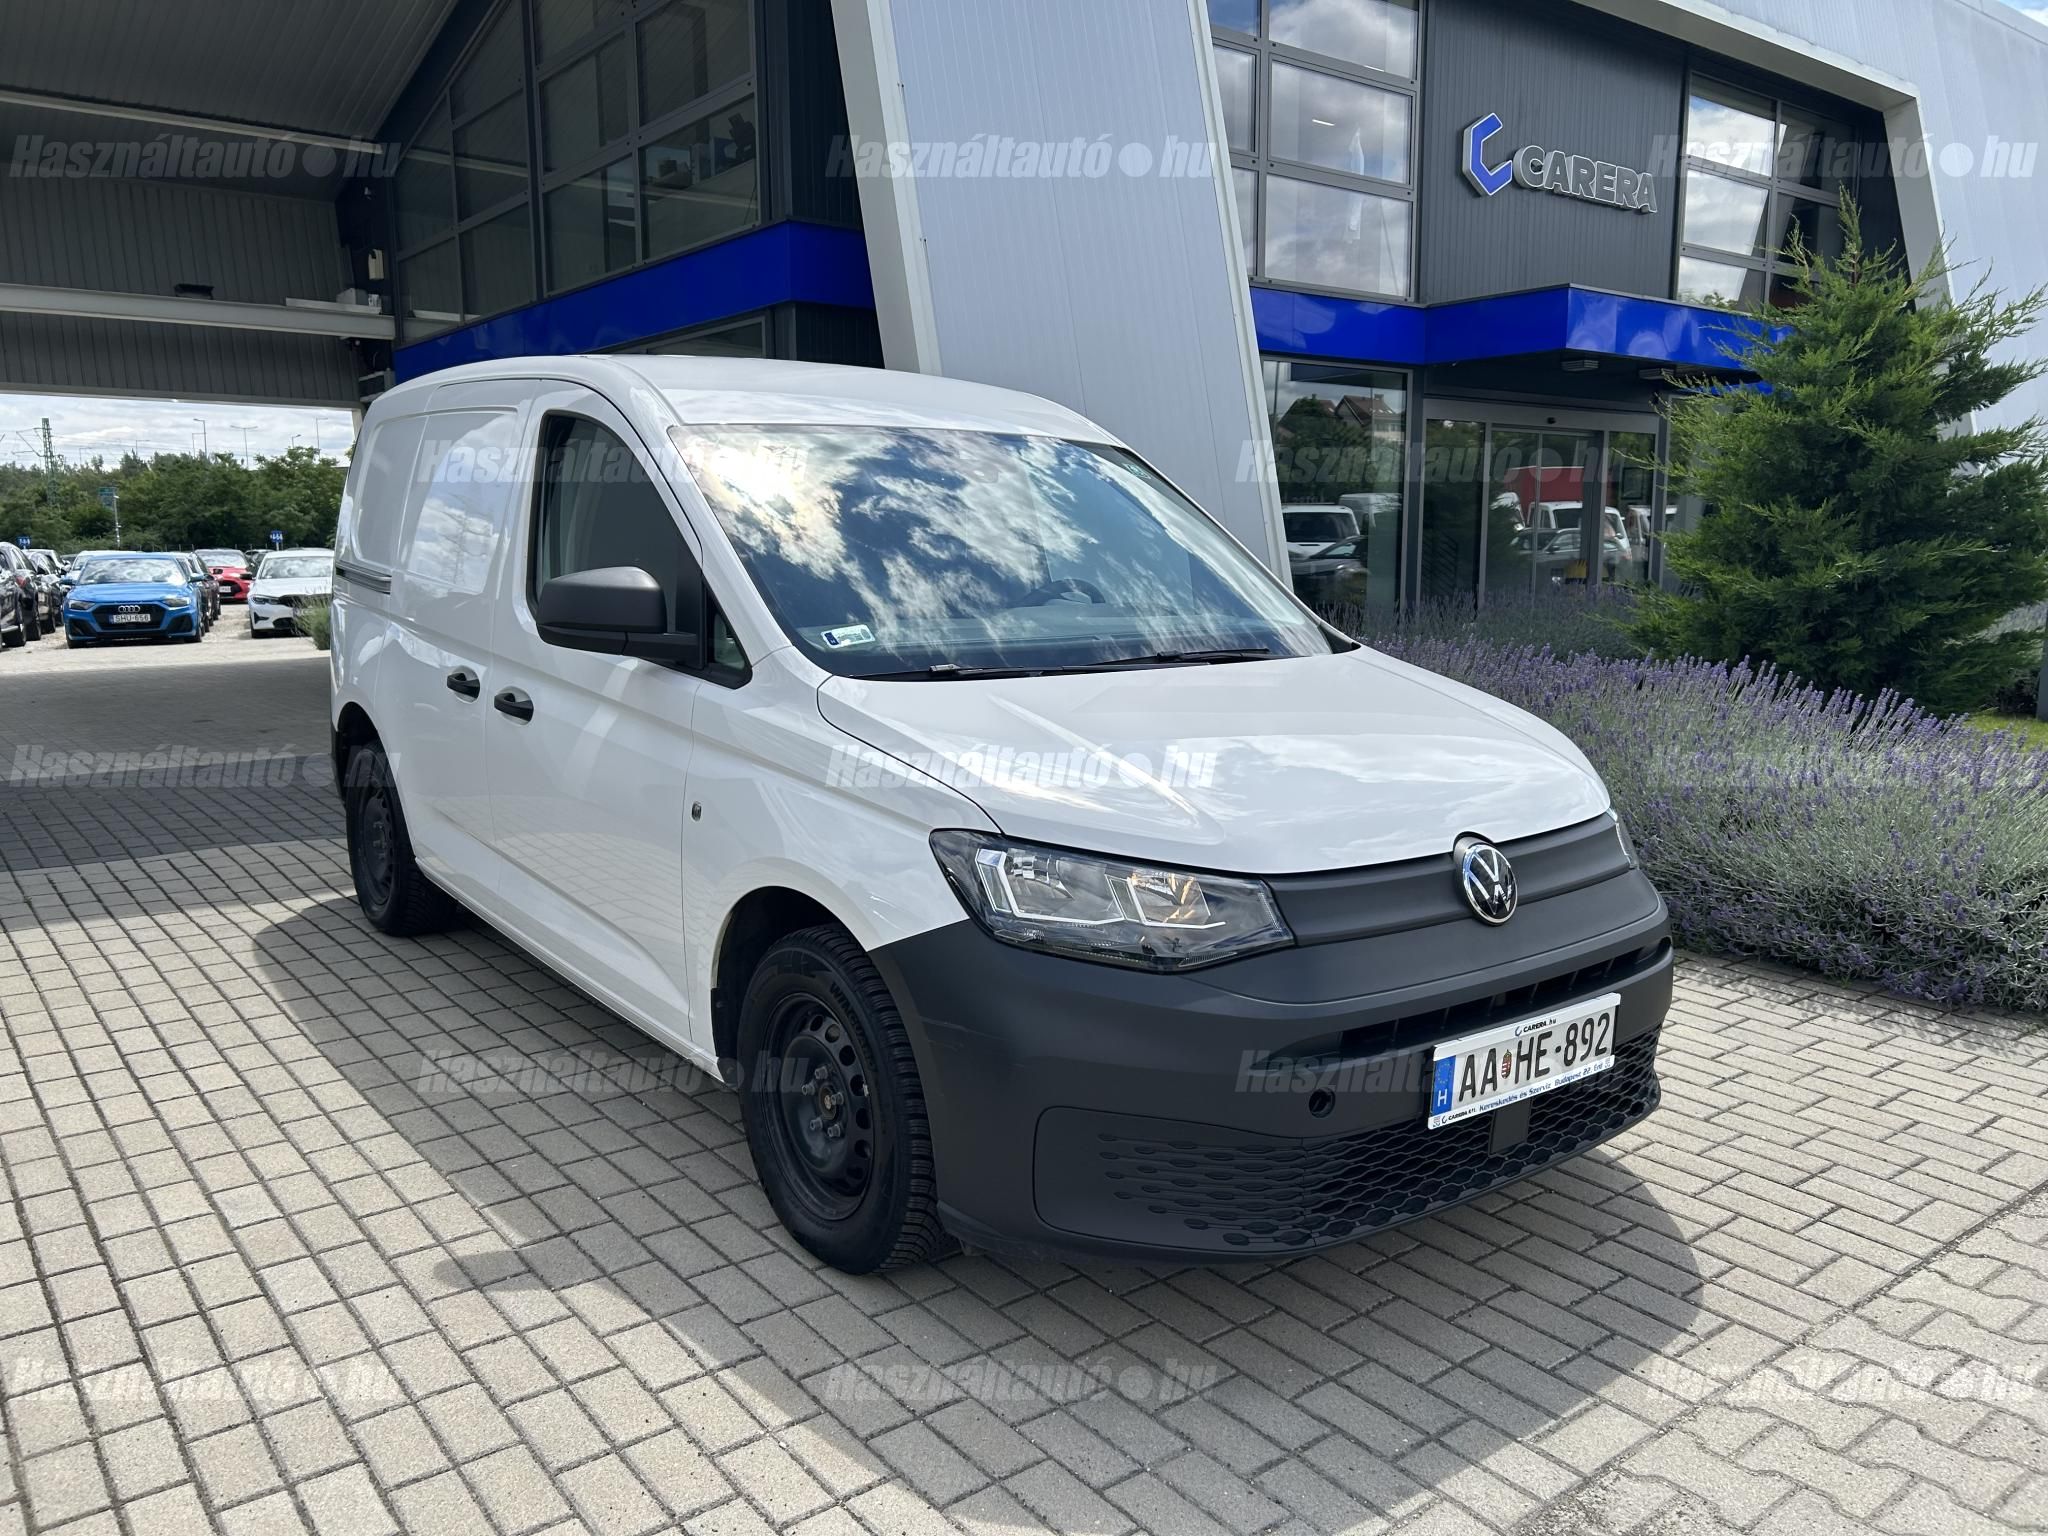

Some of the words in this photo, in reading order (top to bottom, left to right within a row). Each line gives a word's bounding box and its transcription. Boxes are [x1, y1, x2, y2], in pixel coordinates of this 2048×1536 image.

[1514, 145, 1657, 213] CARERA
[1528, 1083, 1552, 1096] Szerviz
[1554, 1072, 1582, 1087] Budapest
[1437, 1089, 1448, 1107] H
